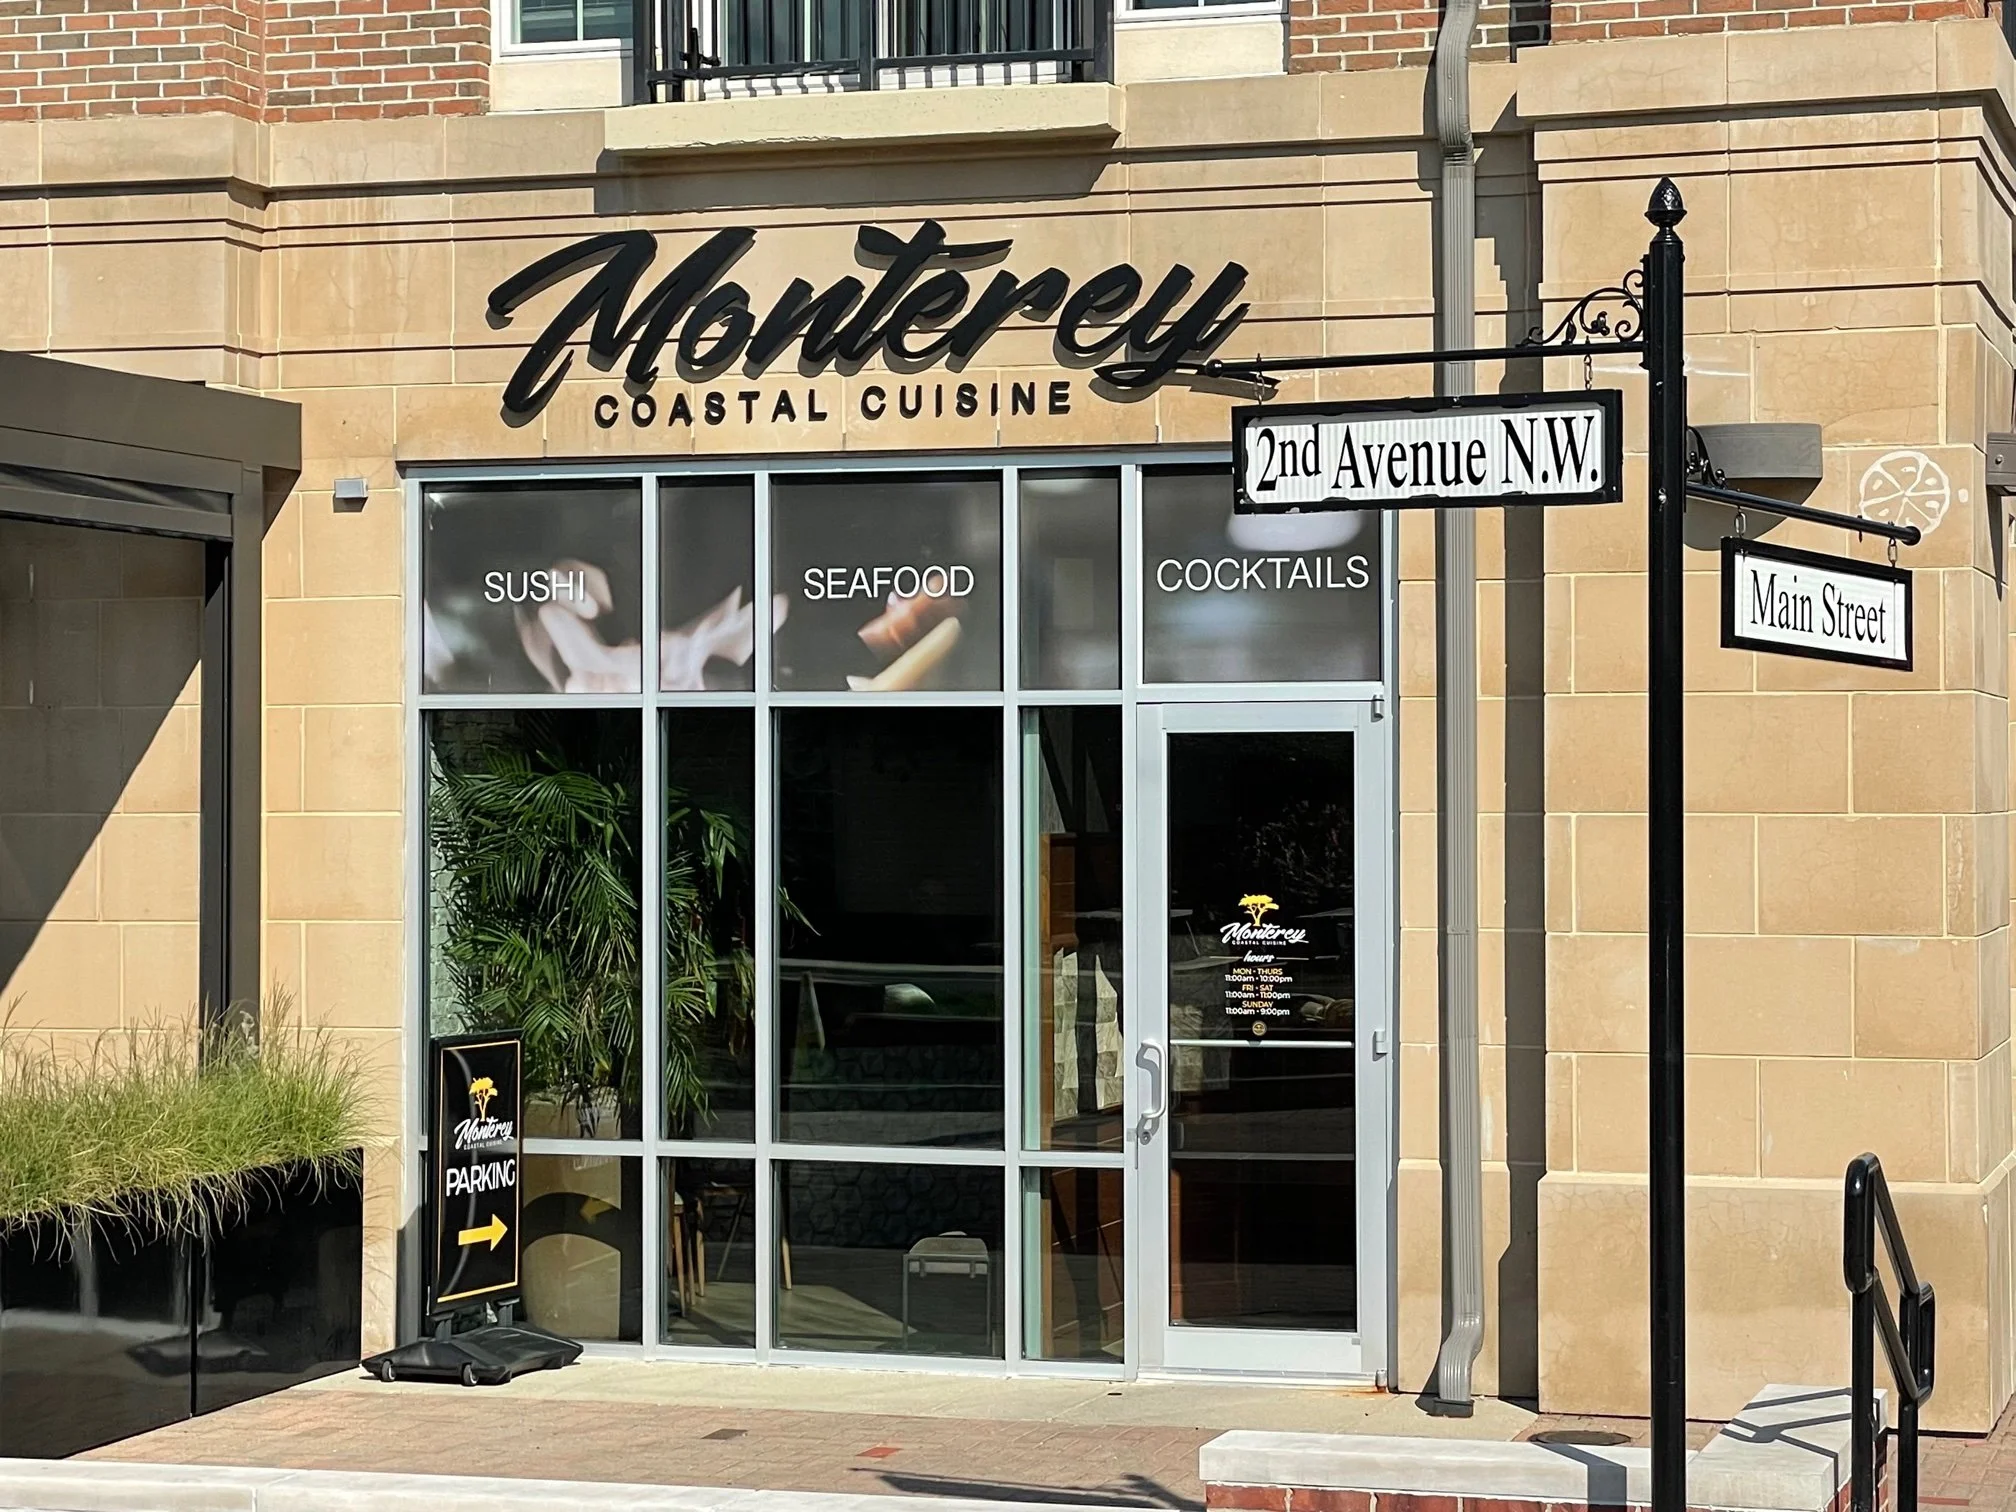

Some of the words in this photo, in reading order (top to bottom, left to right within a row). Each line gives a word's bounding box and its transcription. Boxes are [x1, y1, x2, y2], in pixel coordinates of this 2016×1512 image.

[488, 218, 1281, 411] Monterey
[594, 389, 828, 428] COASTAL
[861, 381, 1071, 420] CUISINE
[1256, 423, 1320, 492] 2nd
[1331, 425, 1487, 490] Avenue
[1501, 415, 1599, 484] N.W.
[484, 570, 584, 603] SUSHI
[803, 565, 975, 600] SEAFOOD
[1156, 555, 1370, 592] COCKTAILS
[1750, 569, 1814, 633] Main
[1822, 582, 1886, 644] Street
[1220, 922, 1309, 944] Monterey
[1243, 950, 1275, 963] hours
[1225, 974, 1255, 982] 11:00am
[1260, 975, 1293, 984] 10:00pm
[1225, 1007, 1256, 1015] 11:00am
[1260, 1008, 1290, 1016] 9:00pm
[1242, 1000, 1274, 1008] SUNDAY
[454, 1116, 515, 1150] Monterey
[446, 1159, 515, 1197] PARKING
